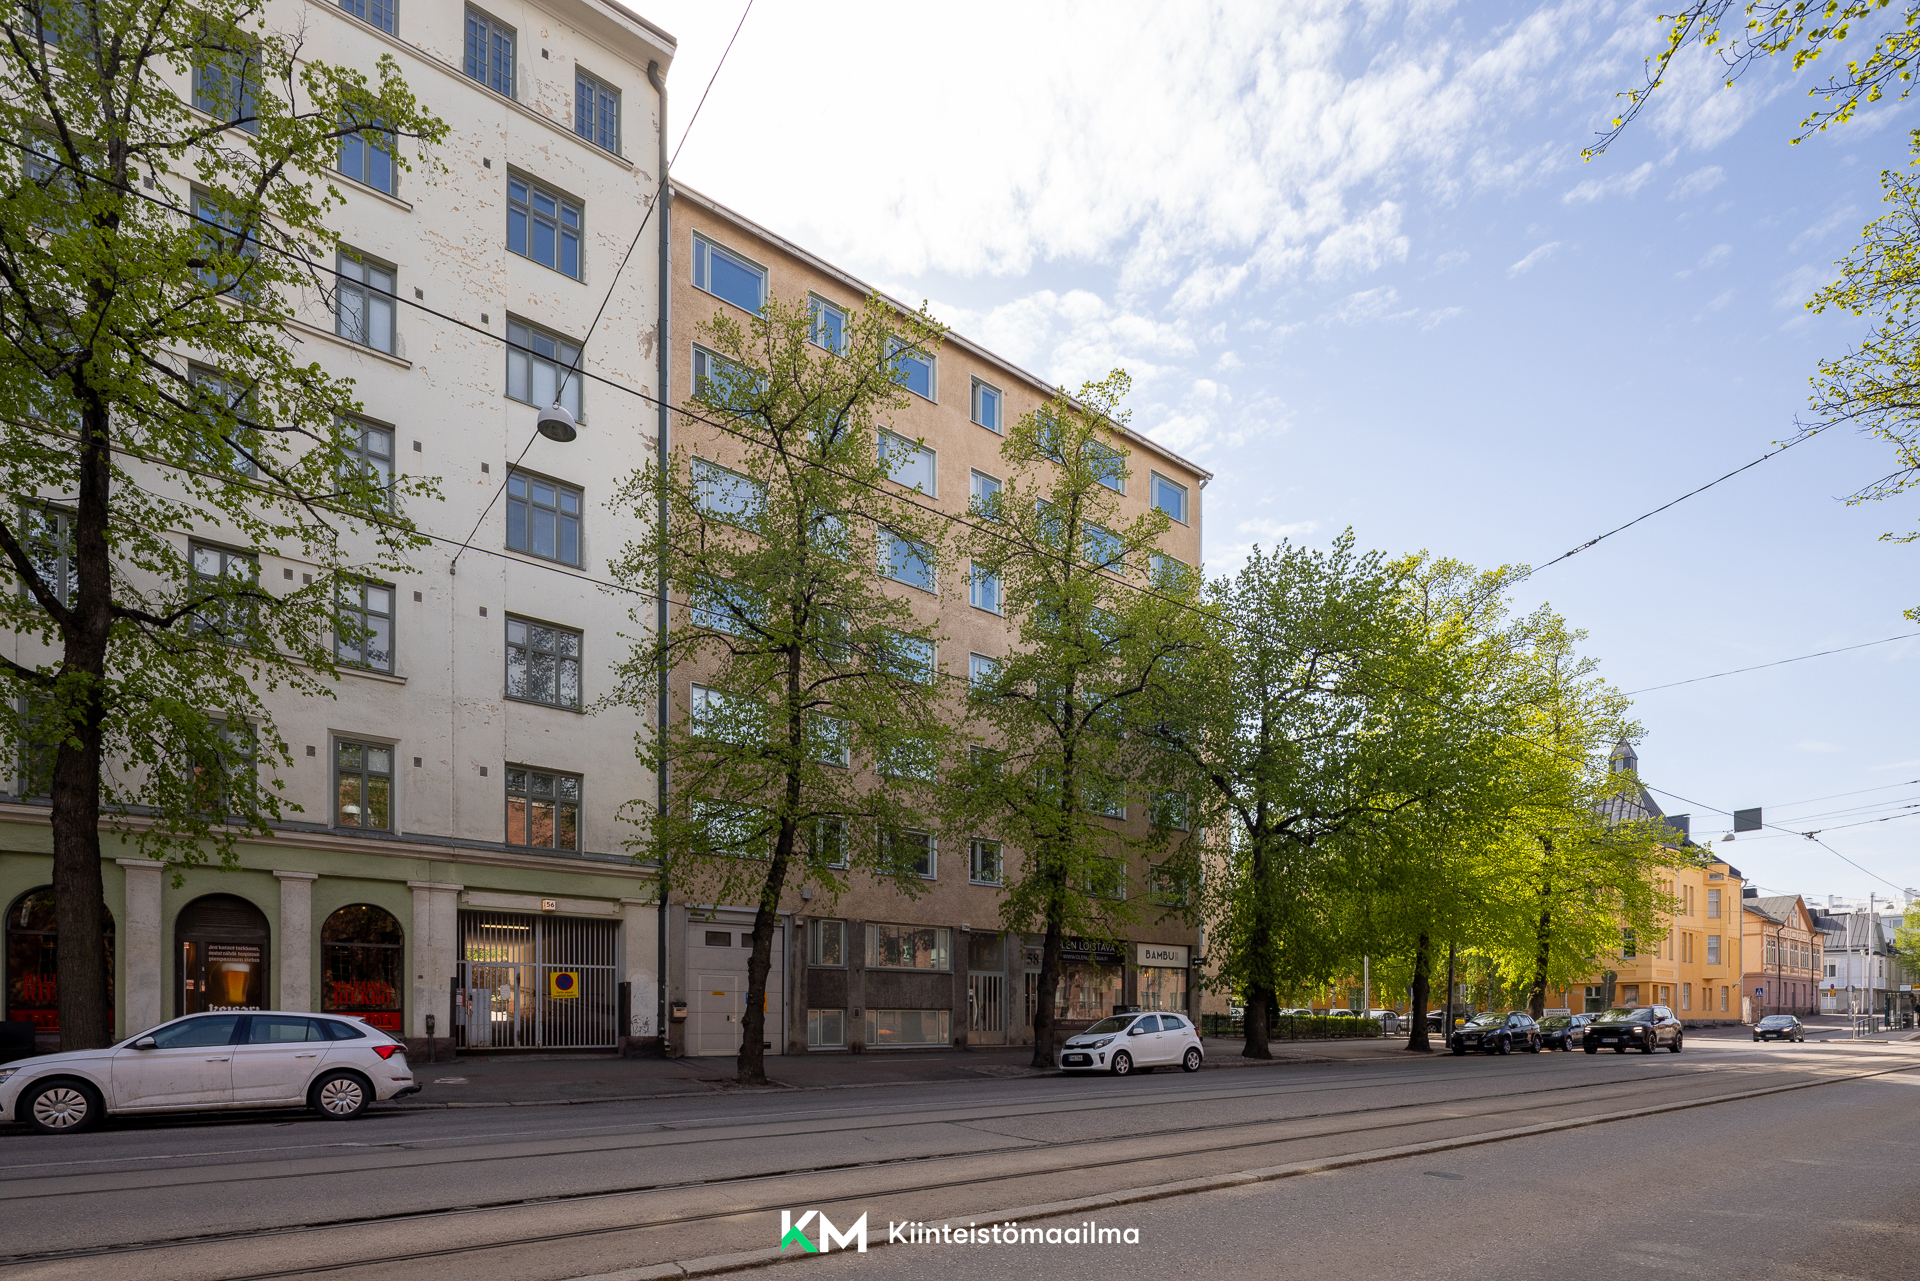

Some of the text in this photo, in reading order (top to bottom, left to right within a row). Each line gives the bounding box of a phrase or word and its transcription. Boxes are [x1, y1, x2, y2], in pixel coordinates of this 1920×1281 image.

[1060, 940, 1077, 950] LEN
[1027, 953, 1039, 965] 58
[1145, 949, 1175, 961] BAMBU
[333, 980, 391, 991] MALTAINEN
[24, 985, 58, 1001] RIE
[334, 991, 391, 1005] RIEKKO
